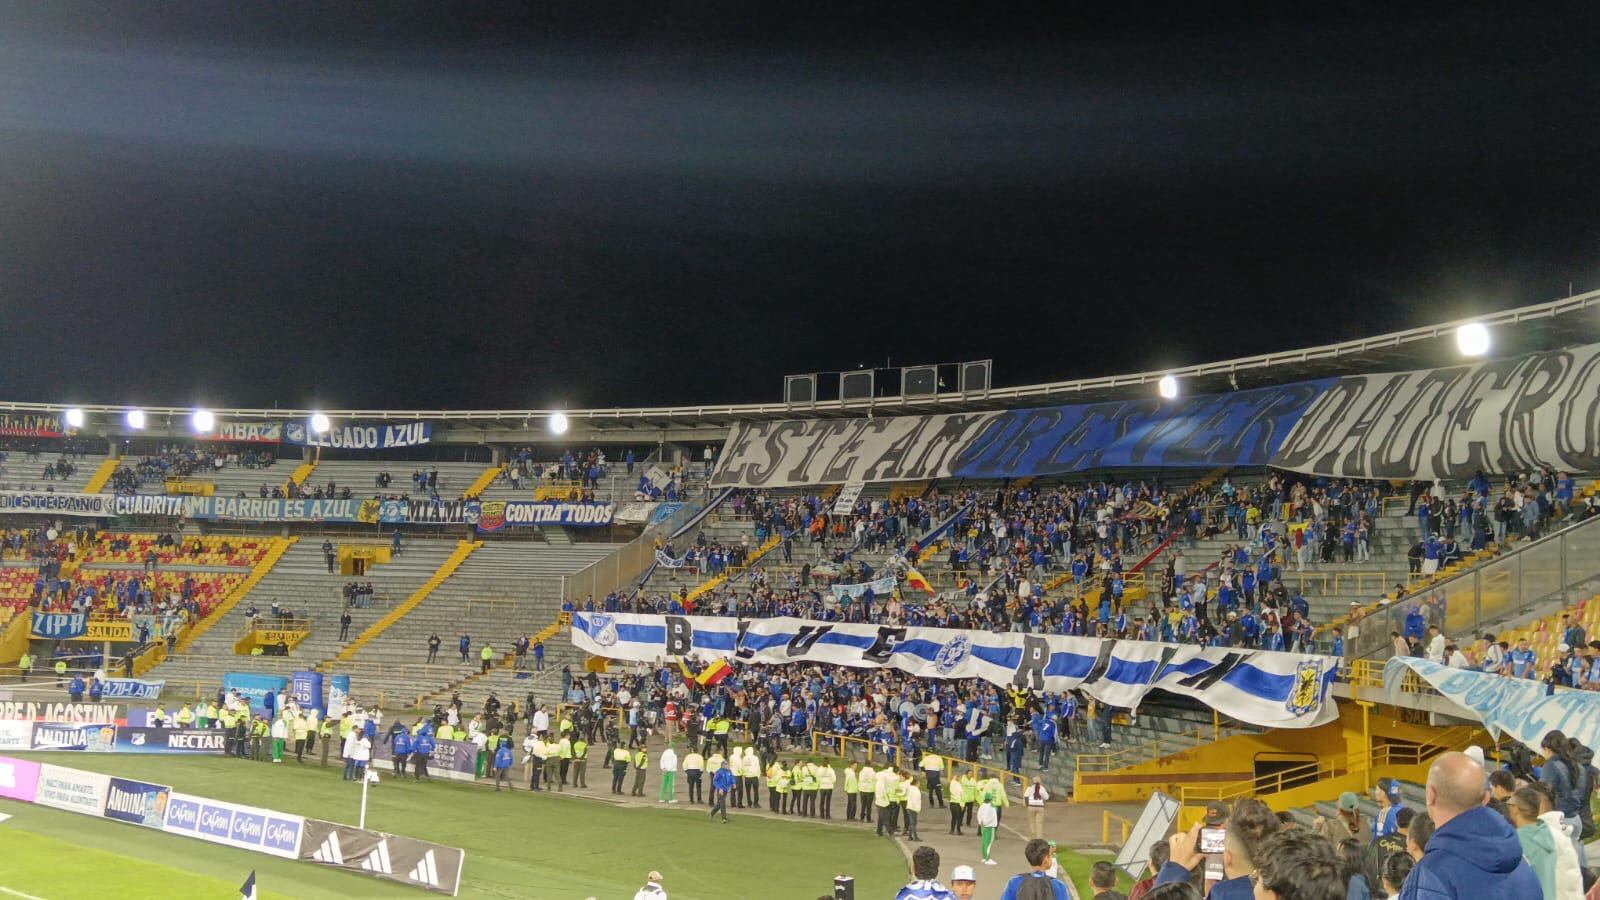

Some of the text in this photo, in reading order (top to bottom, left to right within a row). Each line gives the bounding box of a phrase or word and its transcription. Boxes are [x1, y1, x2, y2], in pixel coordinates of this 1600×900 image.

[383, 422, 430, 447] AZUL
[20, 495, 100, 512] STEFANO
[116, 495, 182, 516] CUADRITA
[192, 496, 354, 518] MI BARRIO ES AZUL
[406, 500, 465, 521] MIAMI
[505, 504, 562, 522] CONTRA
[565, 504, 612, 523] TODOS
[87, 627, 129, 638] SALIDA
[665, 616, 908, 664] BLUE
[45, 703, 118, 723] AGOSTINY
[34, 727, 88, 746] ANDINA
[168, 735, 225, 749] NECTAR
[107, 786, 146, 816] ANDINA
